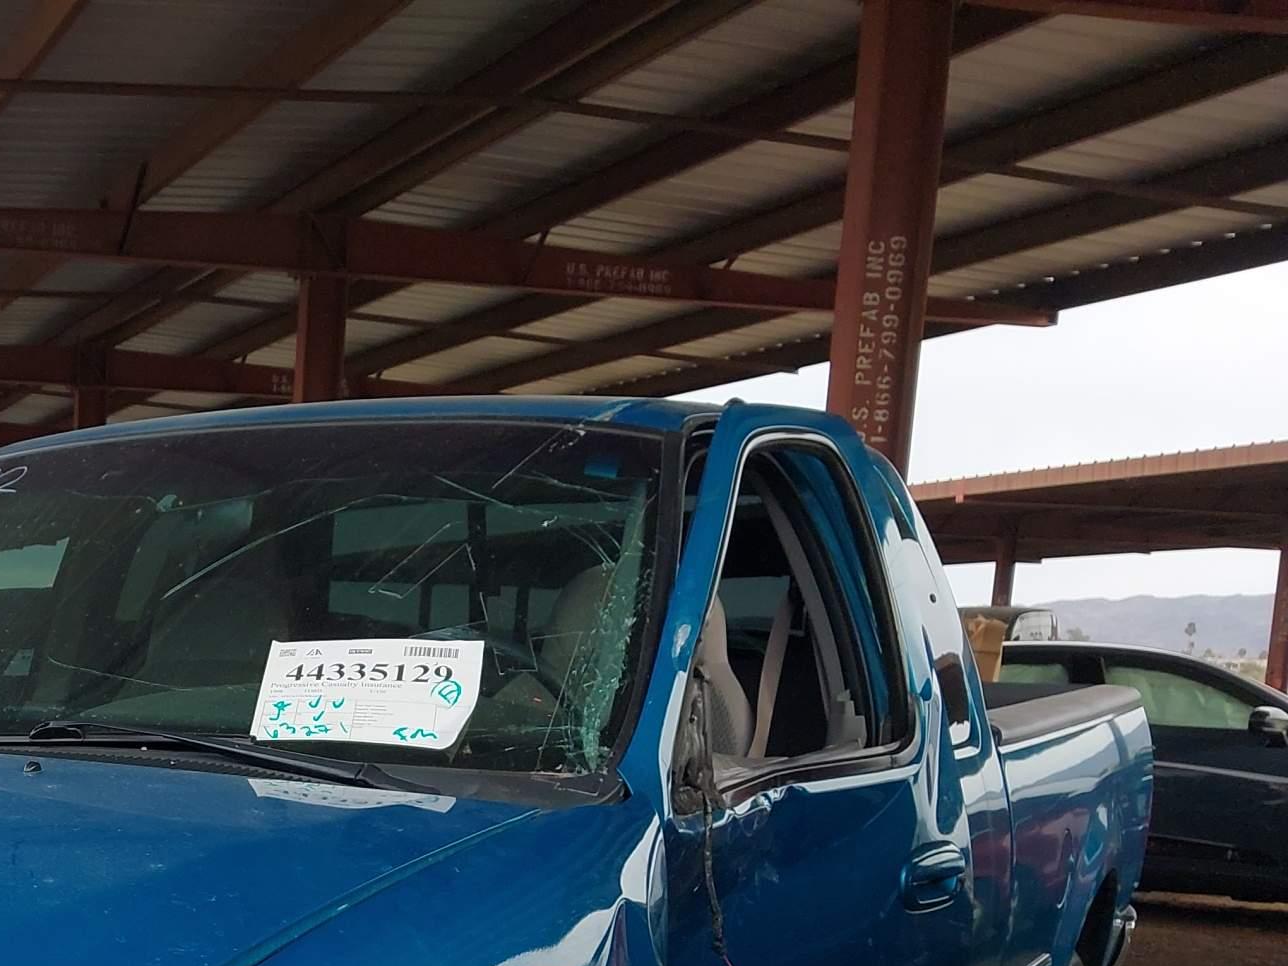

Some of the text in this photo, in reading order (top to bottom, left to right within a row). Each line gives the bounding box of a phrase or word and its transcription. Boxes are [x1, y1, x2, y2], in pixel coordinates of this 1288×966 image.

[866, 240, 886, 279] INC
[855, 291, 881, 386] PREFAB
[285, 661, 454, 685] 44335129
